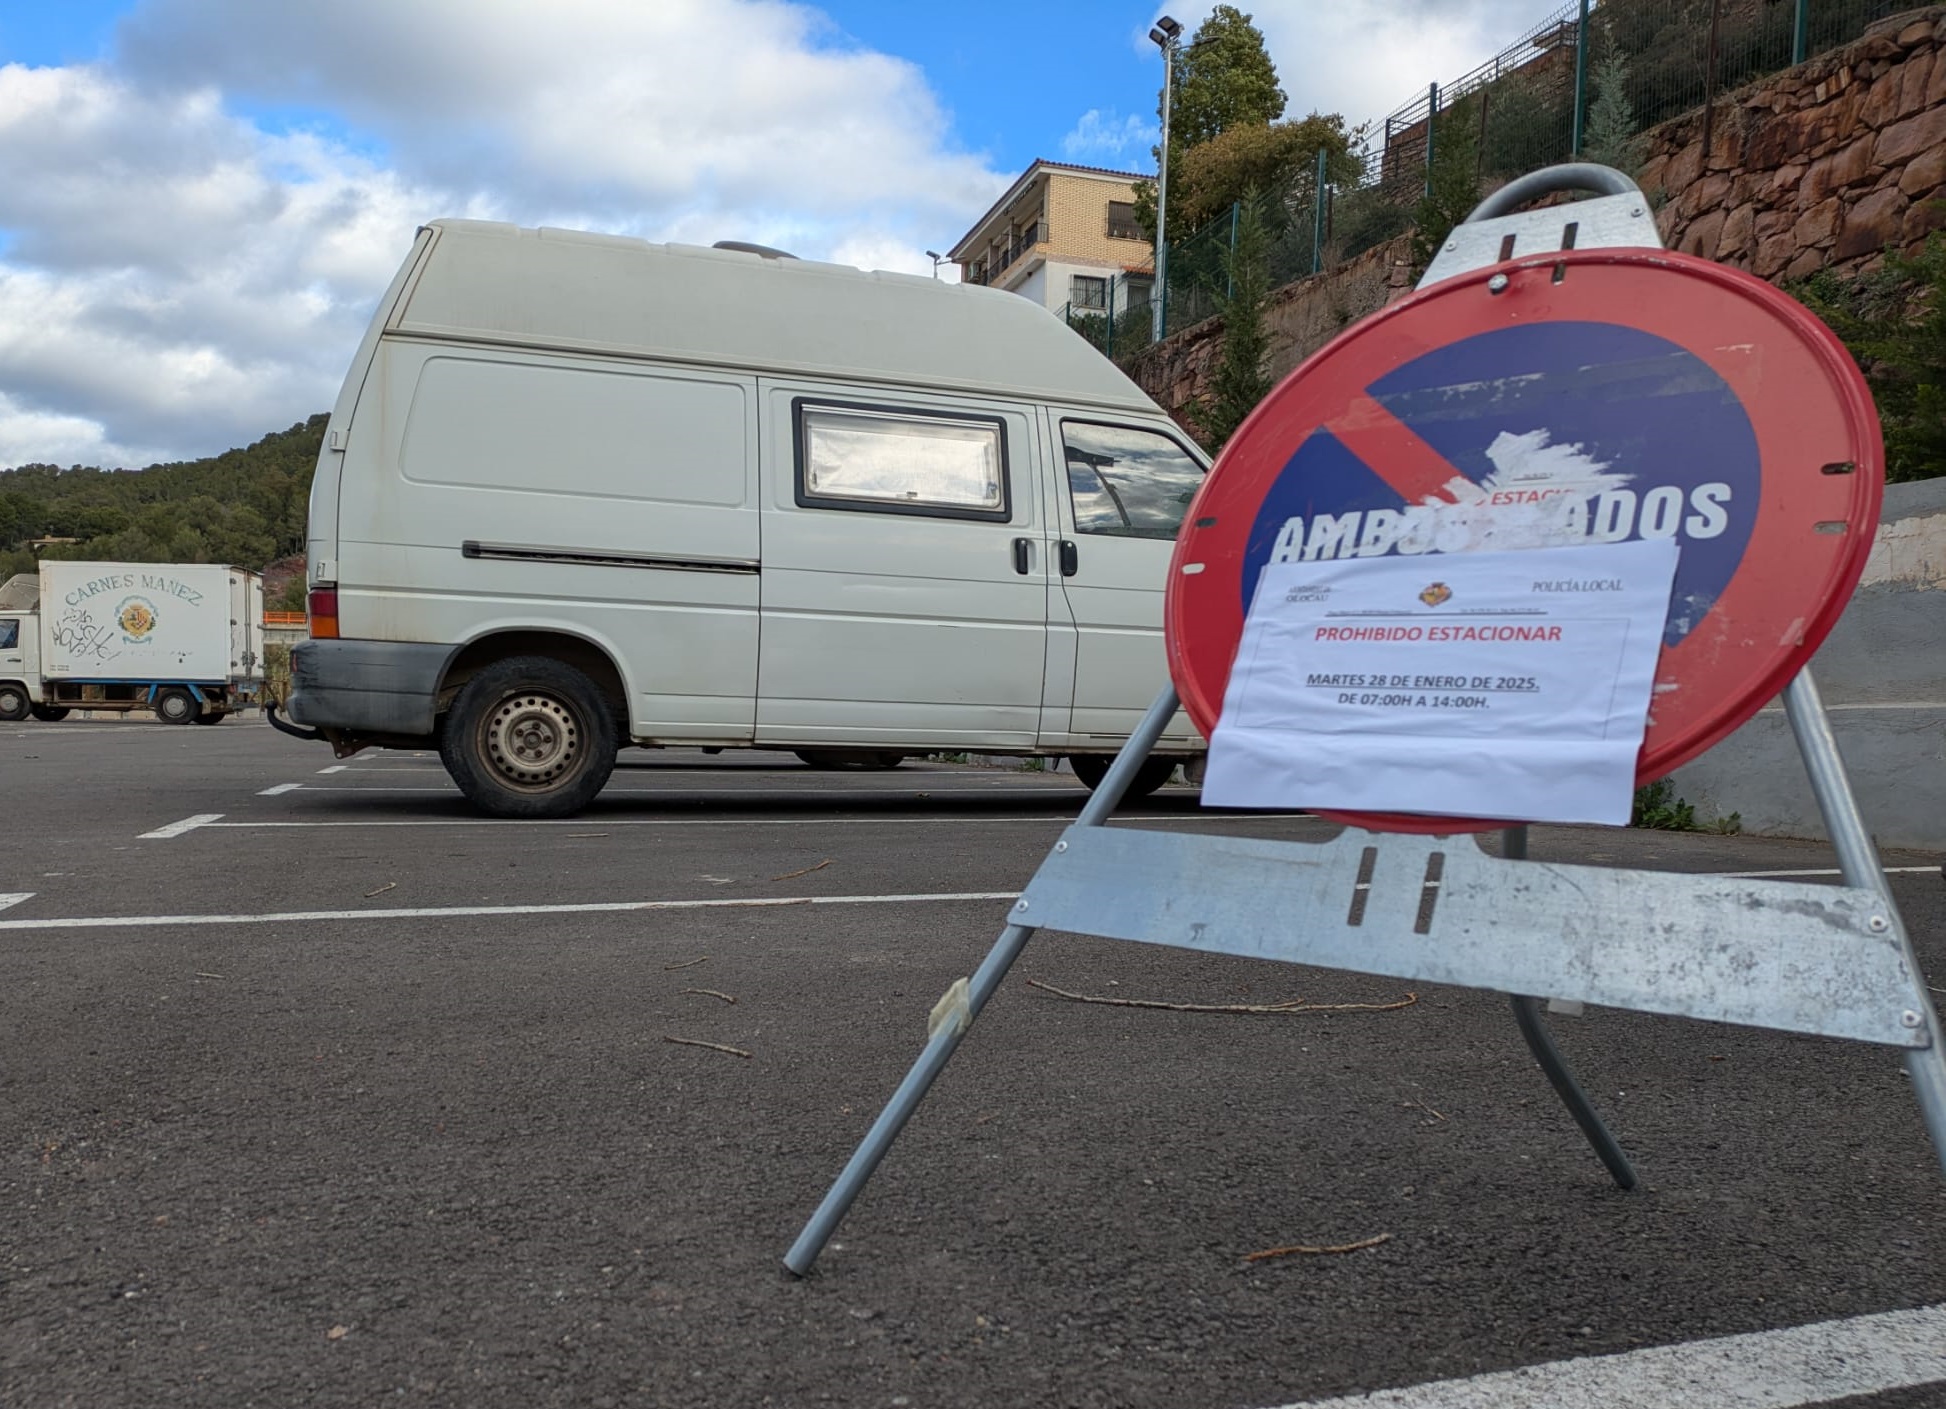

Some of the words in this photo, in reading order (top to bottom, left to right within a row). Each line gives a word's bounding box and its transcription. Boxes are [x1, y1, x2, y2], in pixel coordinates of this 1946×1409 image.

[65, 575, 134, 606] CARNES
[1532, 578, 1580, 592] POLICÍA
[1582, 579, 1624, 591] LOCAL
[1315, 627, 1422, 641] PROHIBIDO
[1427, 626, 1562, 641] ESTACIONAR
[1306, 674, 1365, 686] MARTES
[1368, 675, 1386, 686] 28
[1390, 675, 1410, 687] DE
[1413, 676, 1466, 688] ENERO
[1471, 677, 1491, 689] DE
[1495, 677, 1540, 690] 2025.
[1338, 693, 1358, 704] DE
[1360, 694, 1412, 706] 07:00H
[1415, 695, 1428, 707] A
[1431, 696, 1490, 708] 14:00H.
